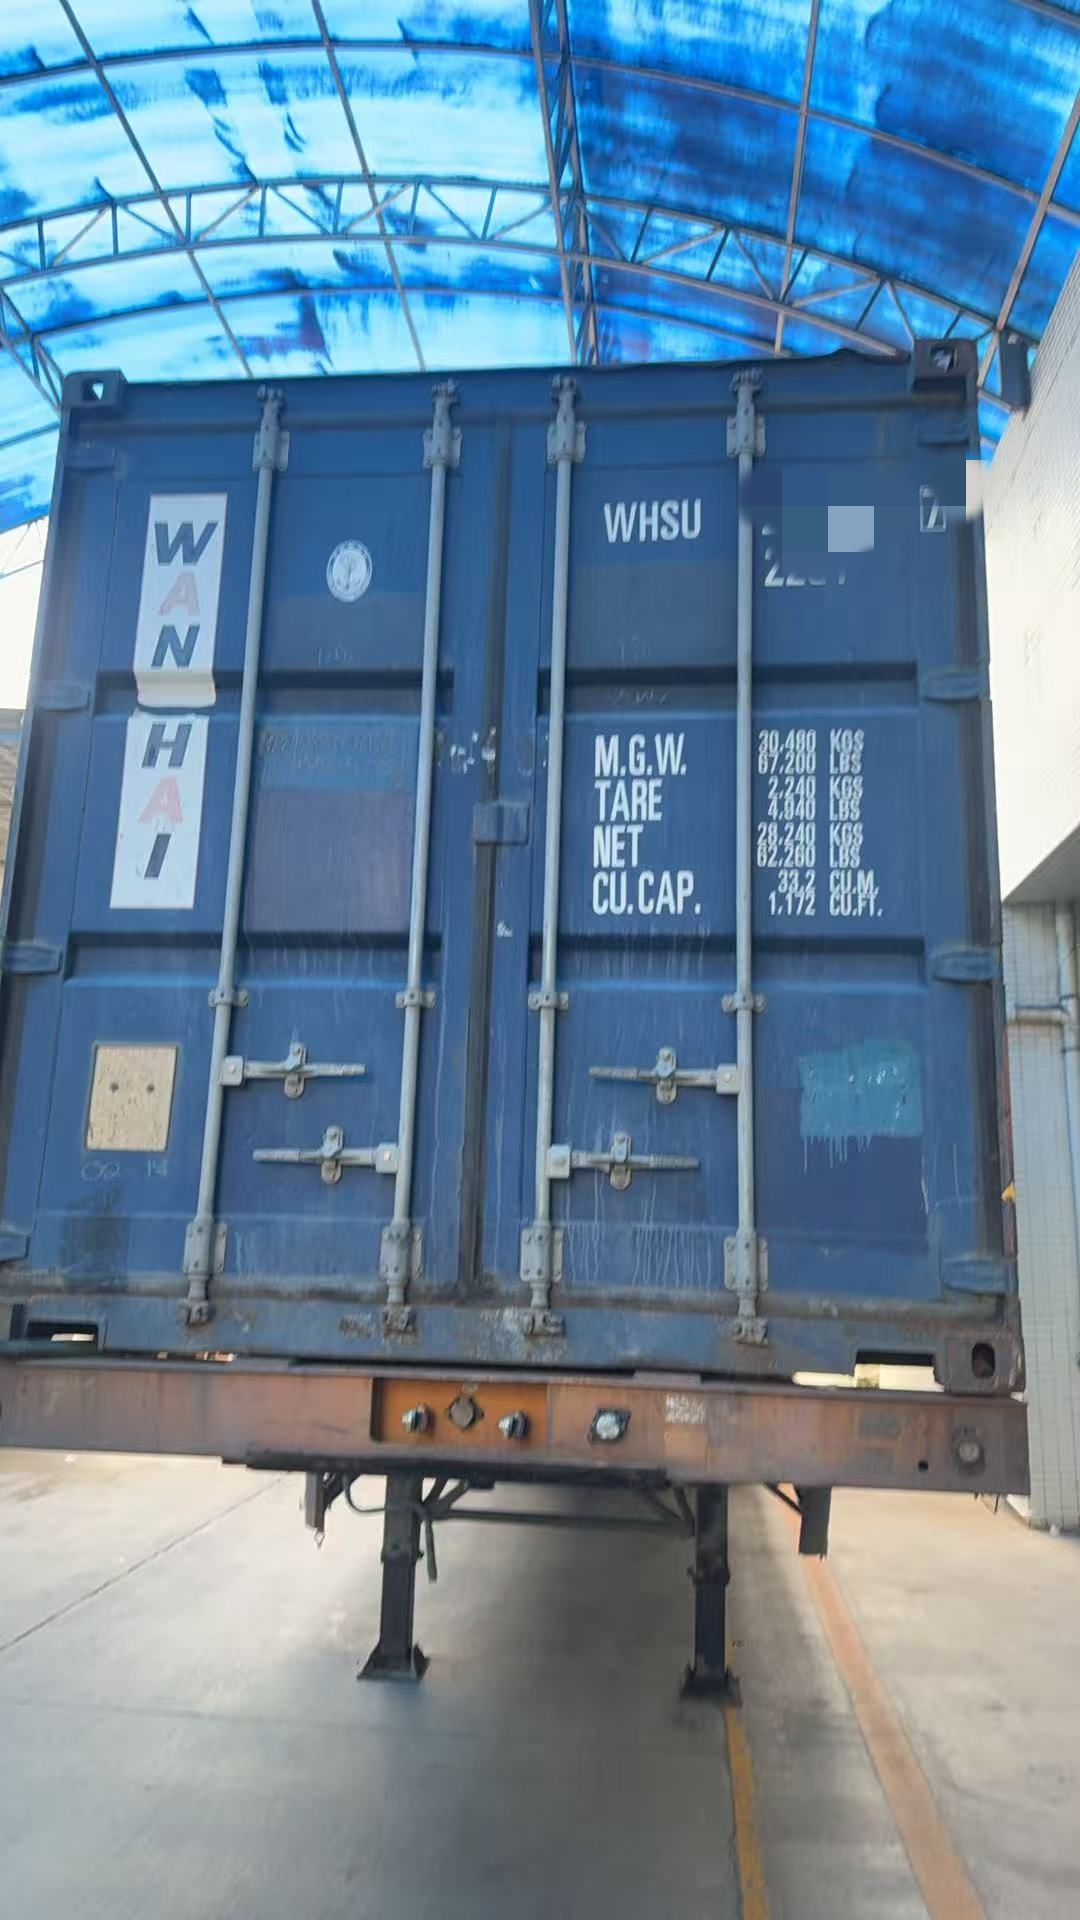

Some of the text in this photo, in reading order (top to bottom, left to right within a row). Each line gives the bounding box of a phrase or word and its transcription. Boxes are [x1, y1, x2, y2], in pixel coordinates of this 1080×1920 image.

[603, 498, 702, 544] WHSU
[138, 521, 218, 879] WAN HAI
[594, 733, 687, 777] M.G.W.
[829, 728, 865, 753] KGS
[829, 751, 862, 775] LBS
[594, 778, 663, 822] TARE
[767, 775, 864, 800] 2,240 KGS
[829, 797, 861, 821] LBS
[593, 824, 643, 868] NET
[757, 821, 864, 846] 28,240 KGS
[829, 844, 861, 868] LBS
[592, 870, 701, 915] CU.CAP.
